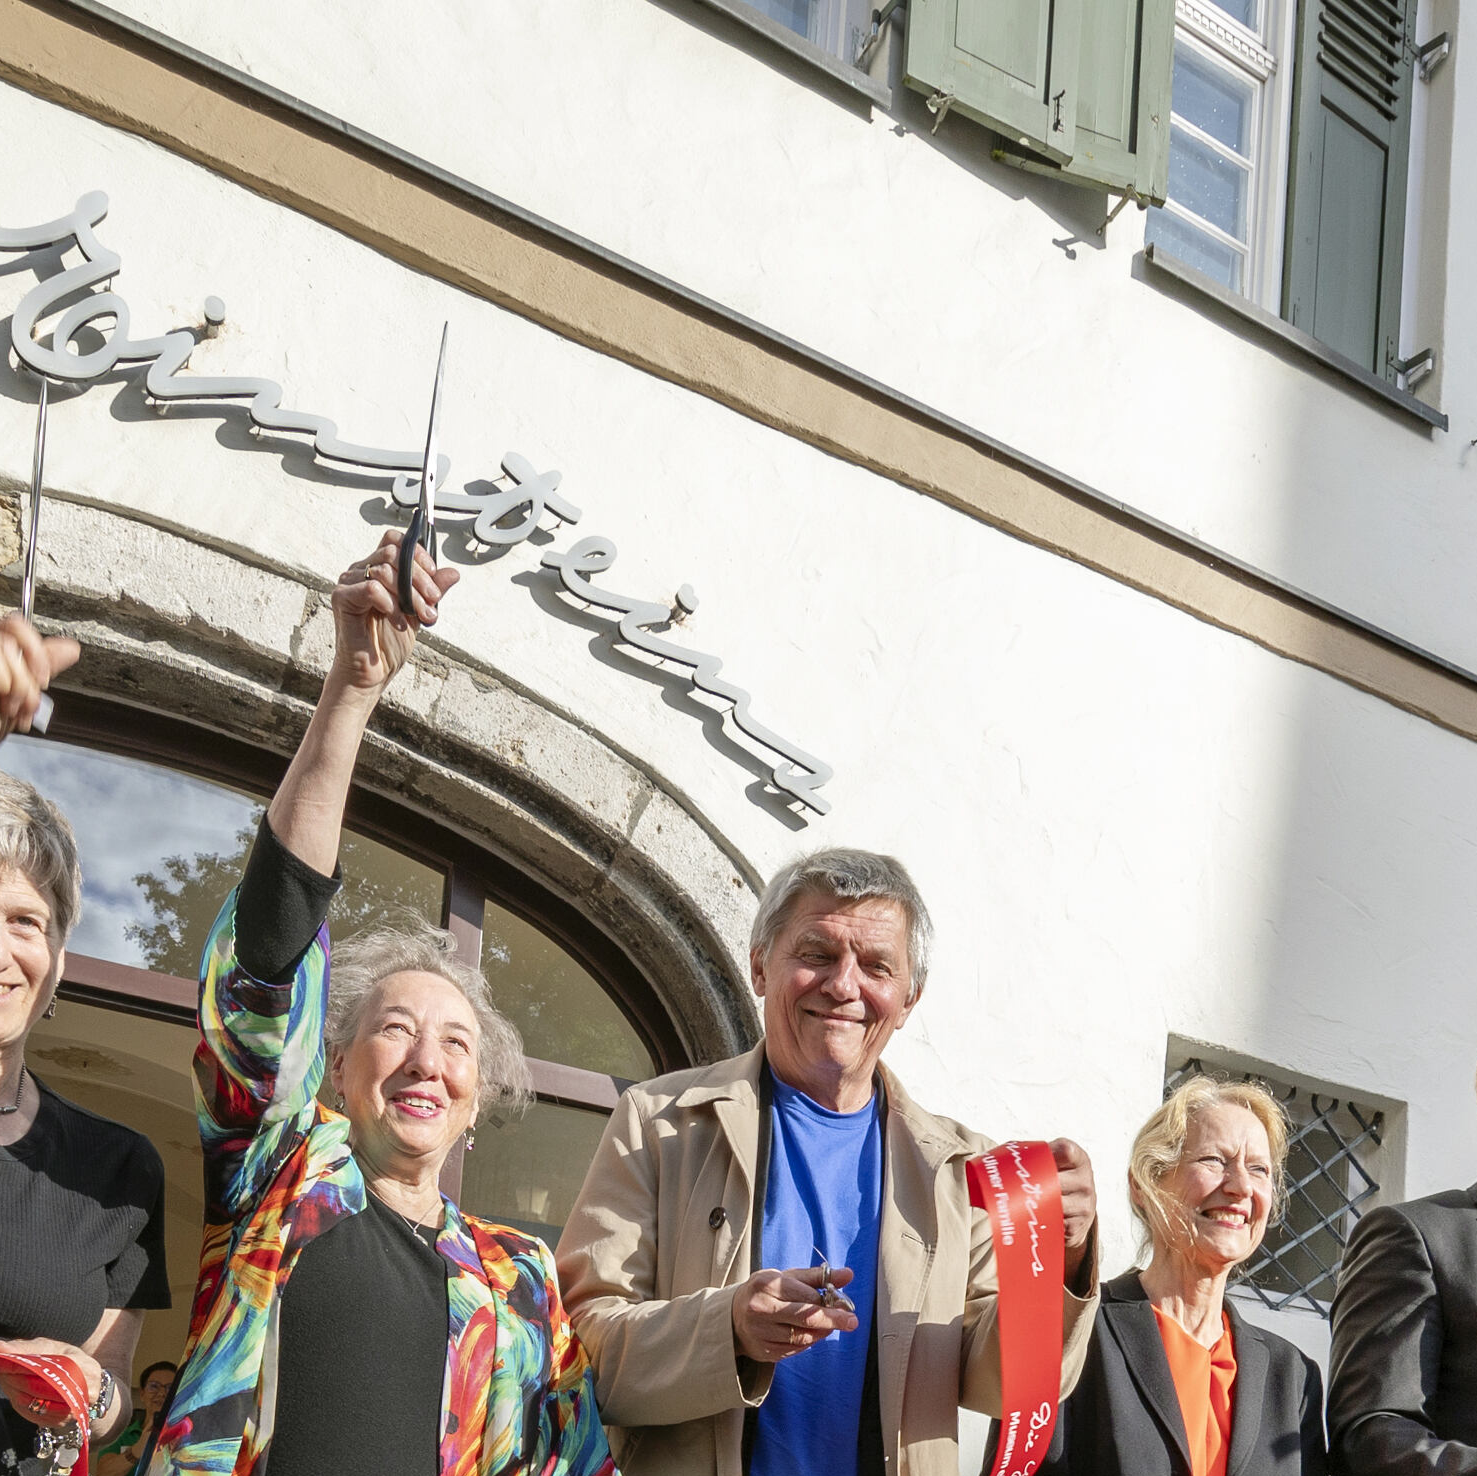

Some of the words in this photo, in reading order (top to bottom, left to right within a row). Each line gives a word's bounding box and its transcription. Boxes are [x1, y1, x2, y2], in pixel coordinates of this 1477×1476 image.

[982, 1154, 1004, 1190] Ulmer
[994, 1192, 1015, 1246] Familie
[1000, 1411, 1021, 1469] Museum
[1026, 1402, 1052, 1453] Die
